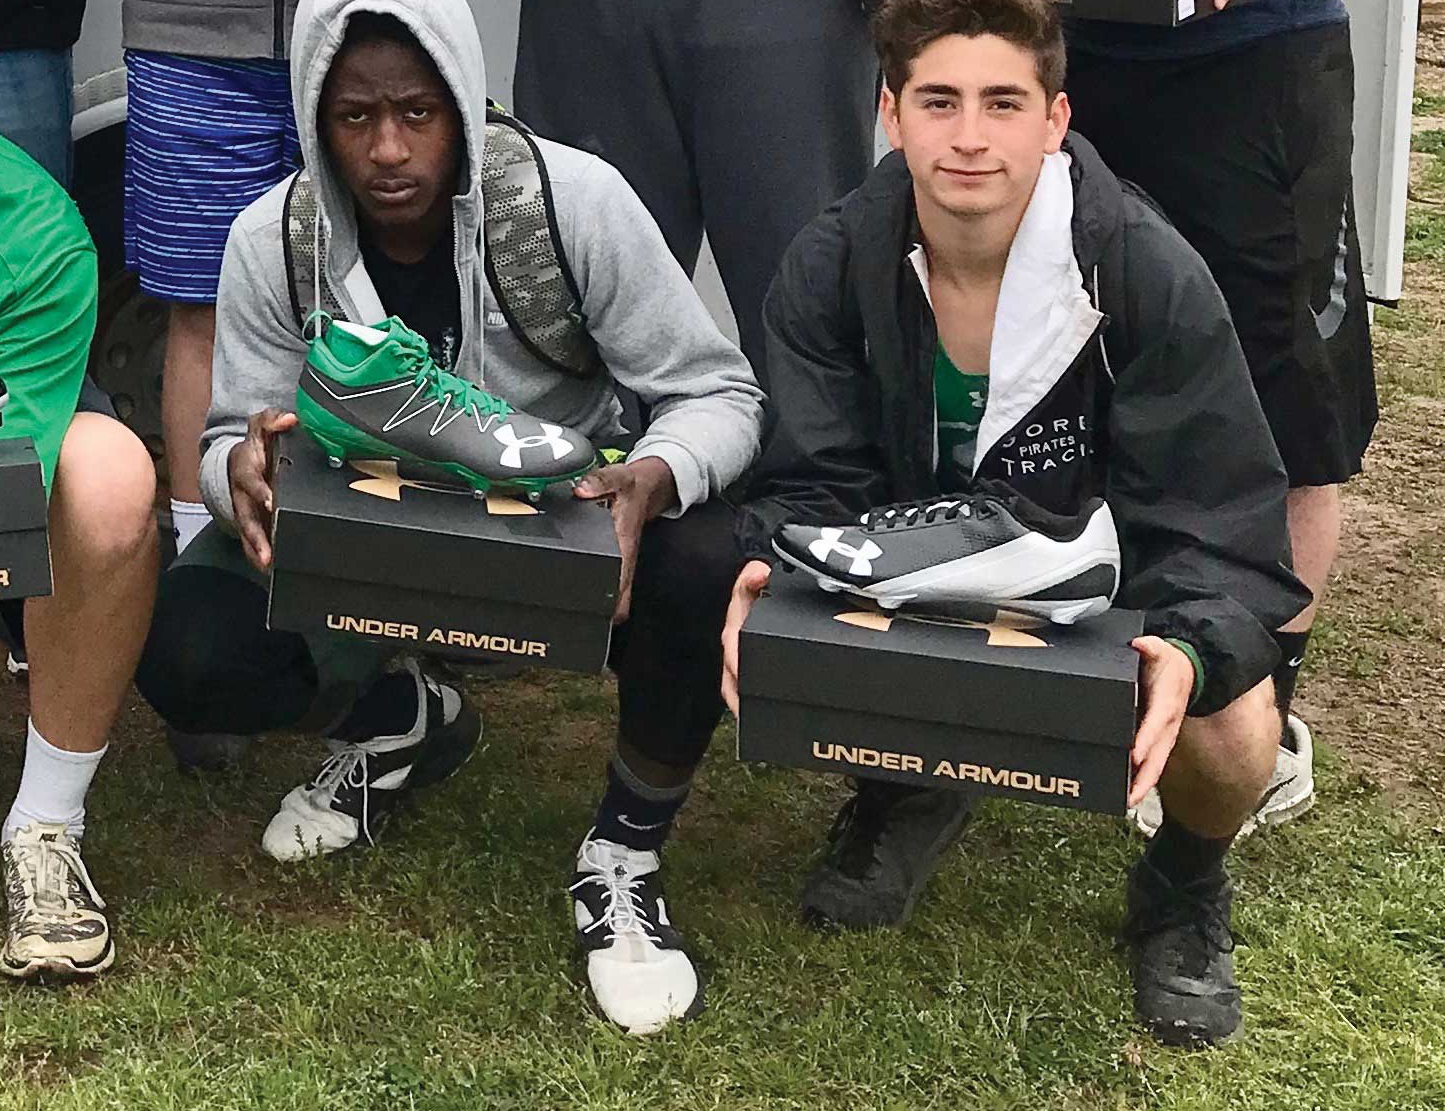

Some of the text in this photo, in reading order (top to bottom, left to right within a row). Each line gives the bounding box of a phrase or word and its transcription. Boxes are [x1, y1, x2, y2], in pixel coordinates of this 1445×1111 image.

[1019, 435, 1076, 457] PIRATES
[326, 614, 547, 657] UNDER ARMOUR
[813, 741, 1081, 797] UNDER ARMOUR
